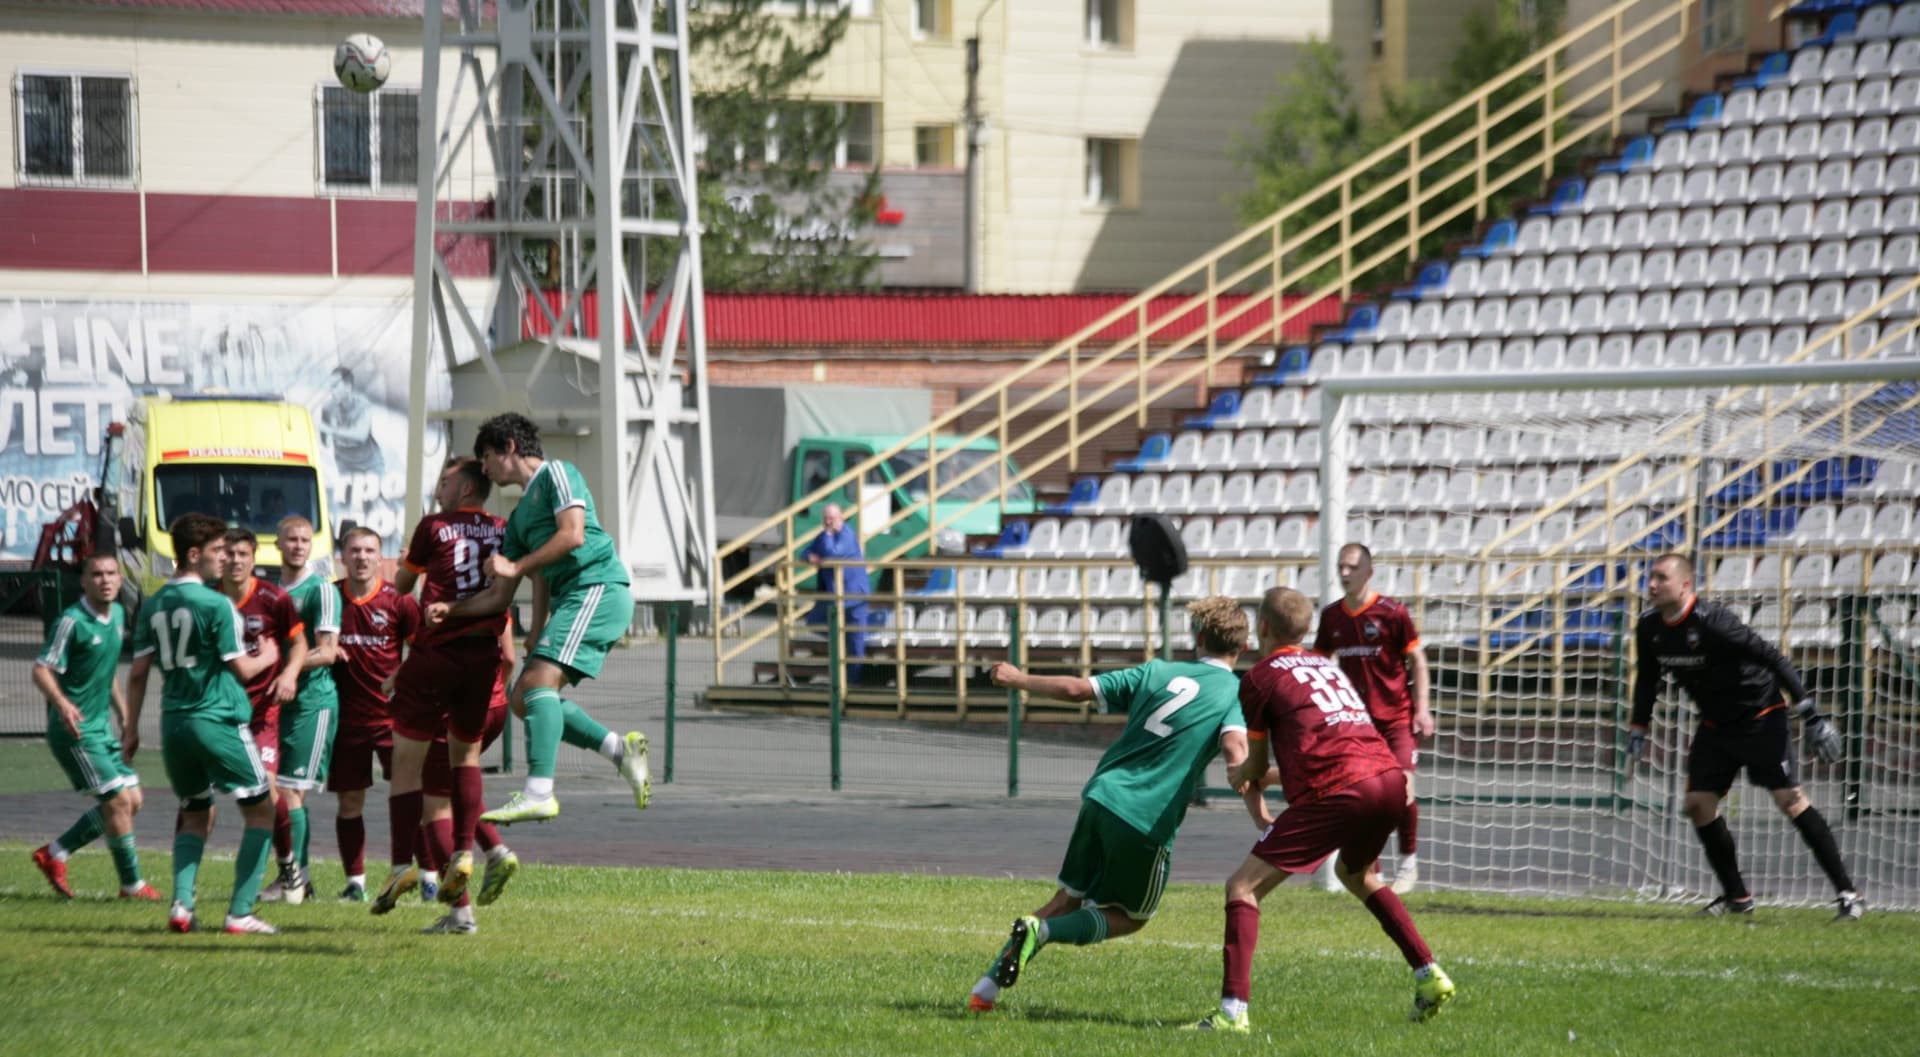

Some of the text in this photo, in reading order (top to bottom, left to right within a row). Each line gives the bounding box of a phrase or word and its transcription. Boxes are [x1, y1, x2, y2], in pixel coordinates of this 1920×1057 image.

[150, 608, 197, 670] 12
[1143, 676, 1200, 738] 2
[1291, 666, 1366, 713] 33
